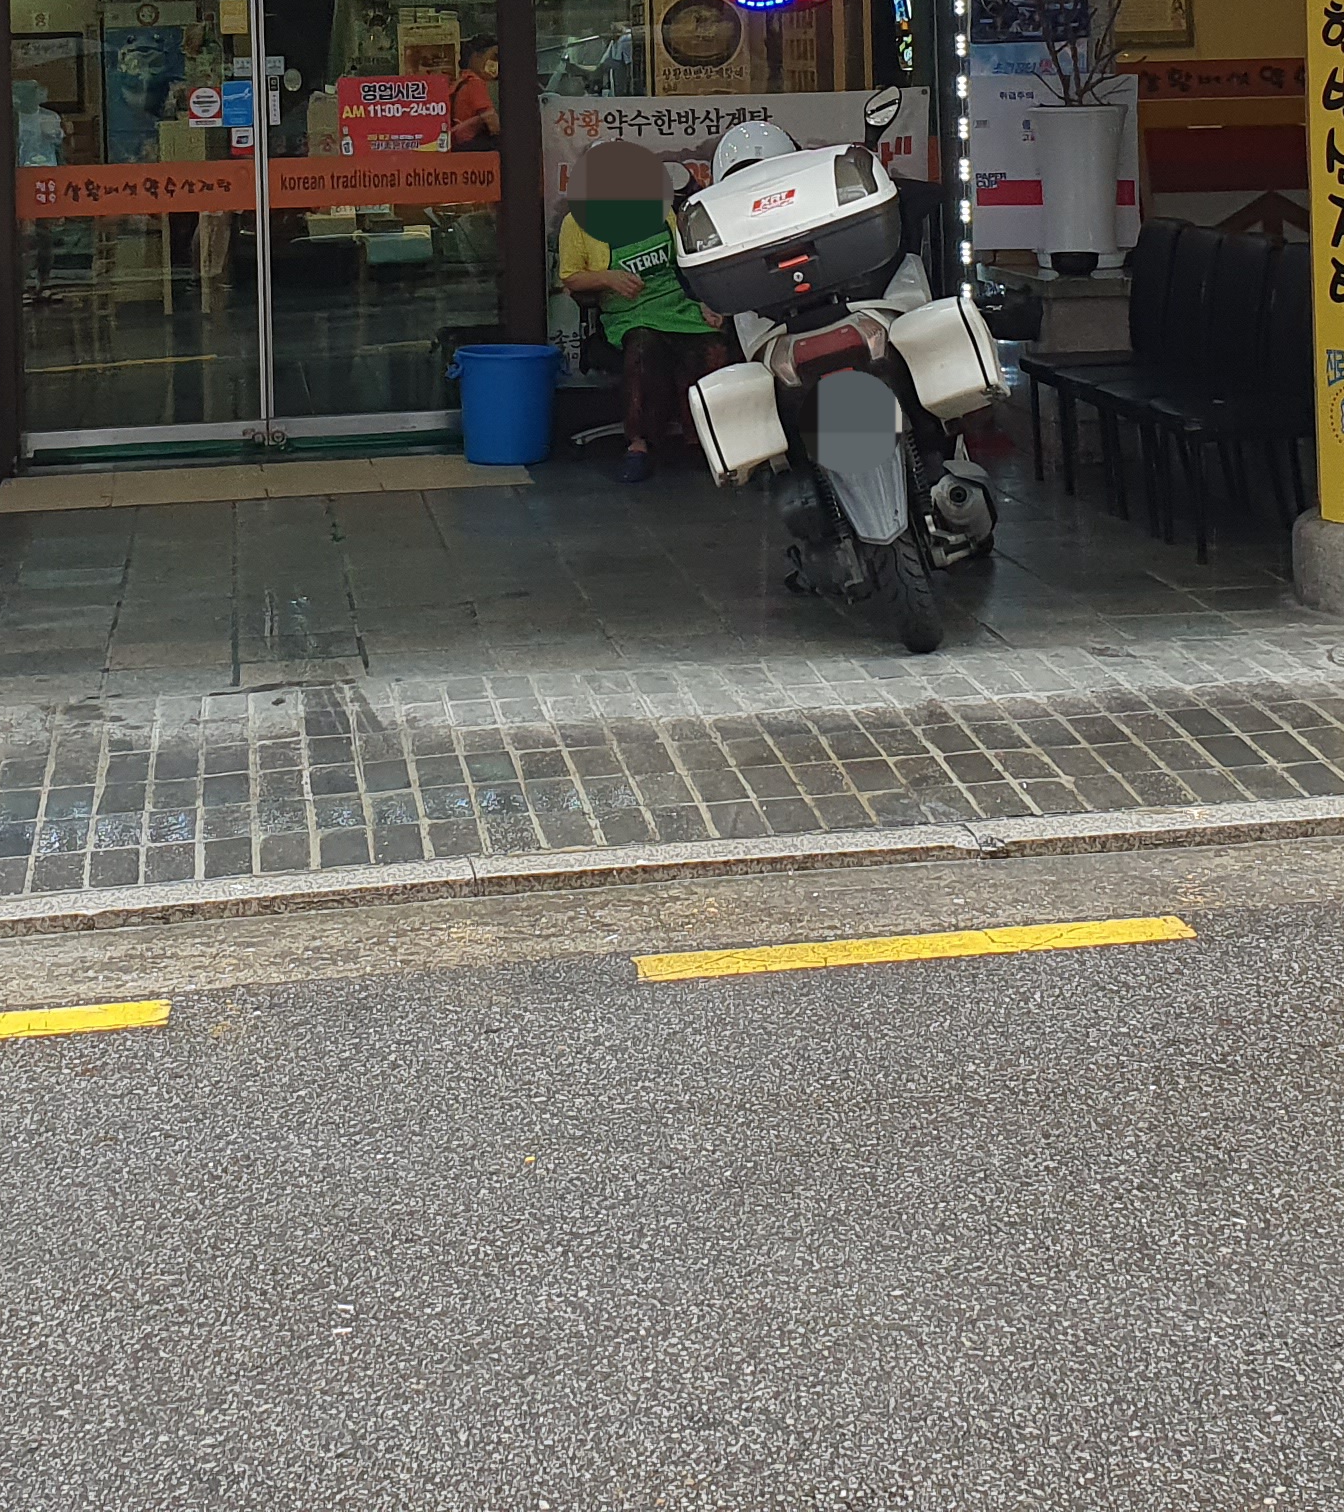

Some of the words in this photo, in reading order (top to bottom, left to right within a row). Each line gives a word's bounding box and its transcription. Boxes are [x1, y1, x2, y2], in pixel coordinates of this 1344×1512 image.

[361, 82, 428, 102] 영업시간
[343, 105, 365, 119] AM
[368, 102, 447, 118] 11:00~24:00
[280, 173, 325, 191] korean
[330, 168, 401, 190] traditional
[406, 168, 458, 188] chicken
[462, 168, 495, 188] soup
[625, 248, 669, 274] TERRA
